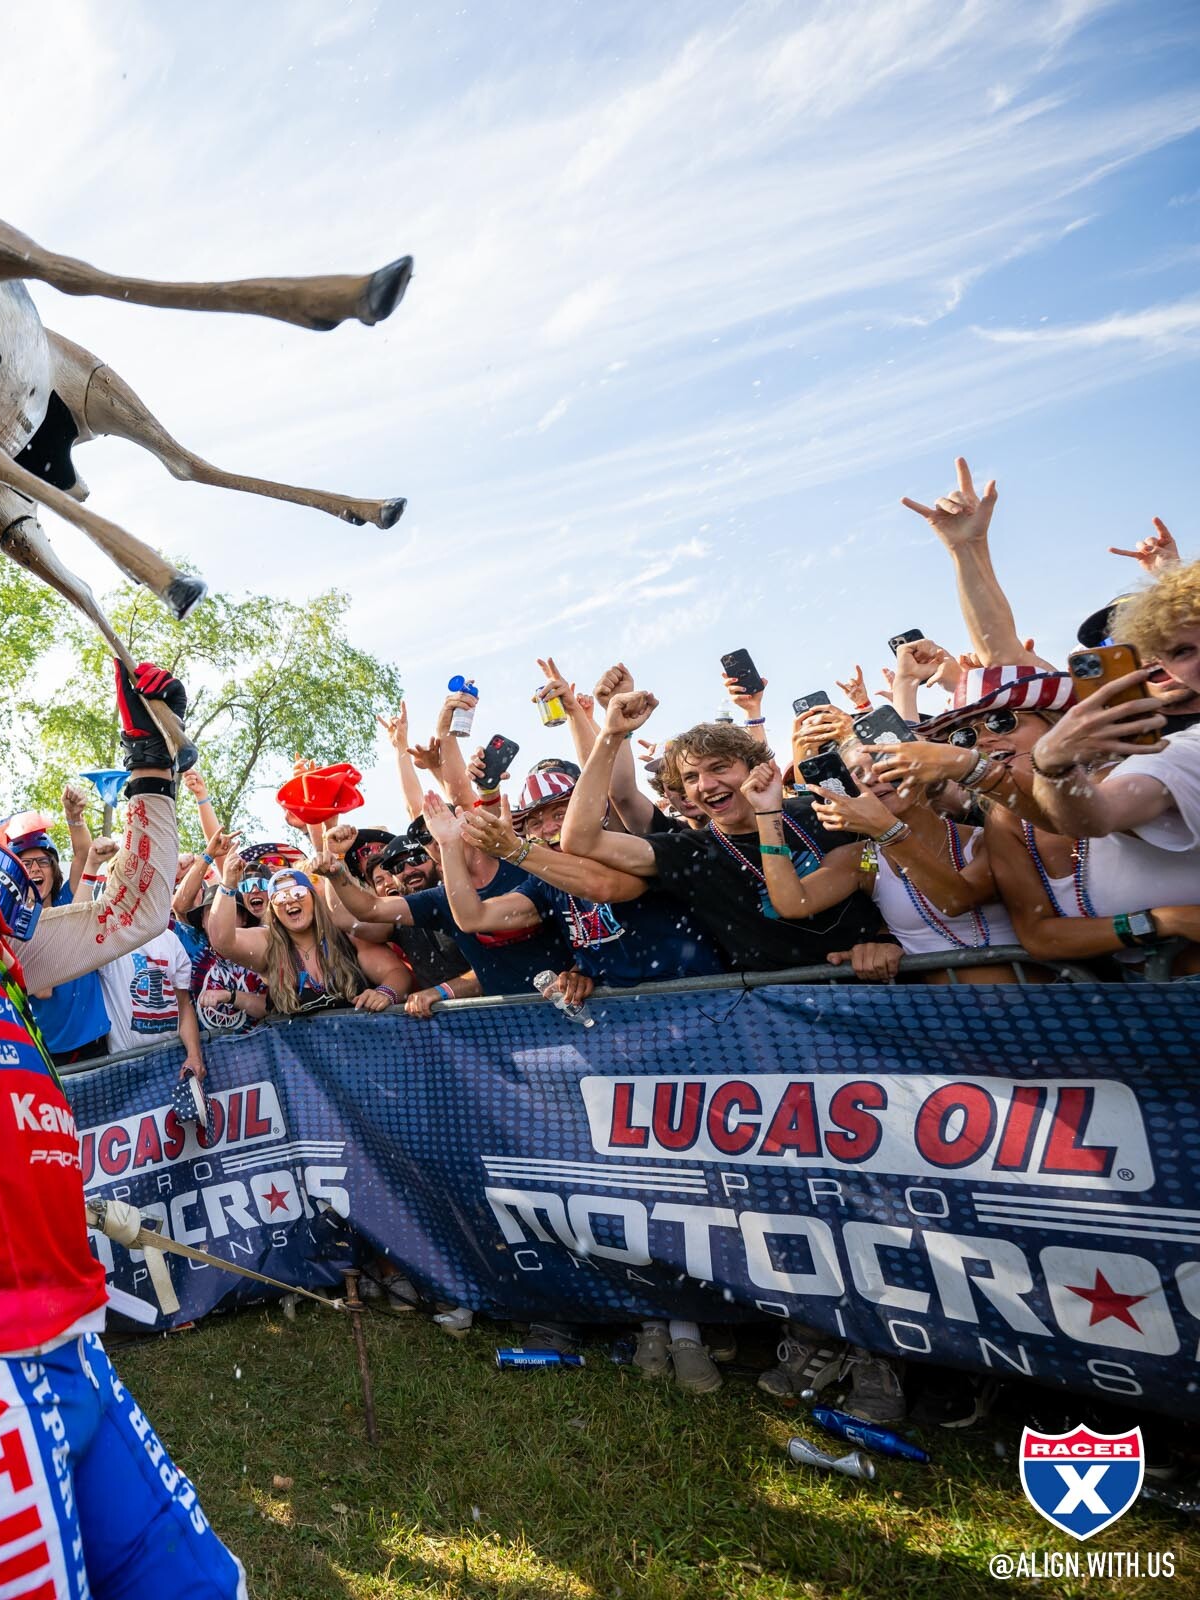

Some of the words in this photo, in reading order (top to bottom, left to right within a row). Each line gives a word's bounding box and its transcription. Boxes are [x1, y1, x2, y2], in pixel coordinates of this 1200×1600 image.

[196, 1087, 272, 1149] OIL
[608, 1081, 888, 1164] LUCAS
[914, 1082, 1119, 1178] OIL
[113, 1161, 213, 1201] PRO
[721, 1172, 950, 1218] PRO
[485, 1186, 1200, 1356] MOTOCRO
